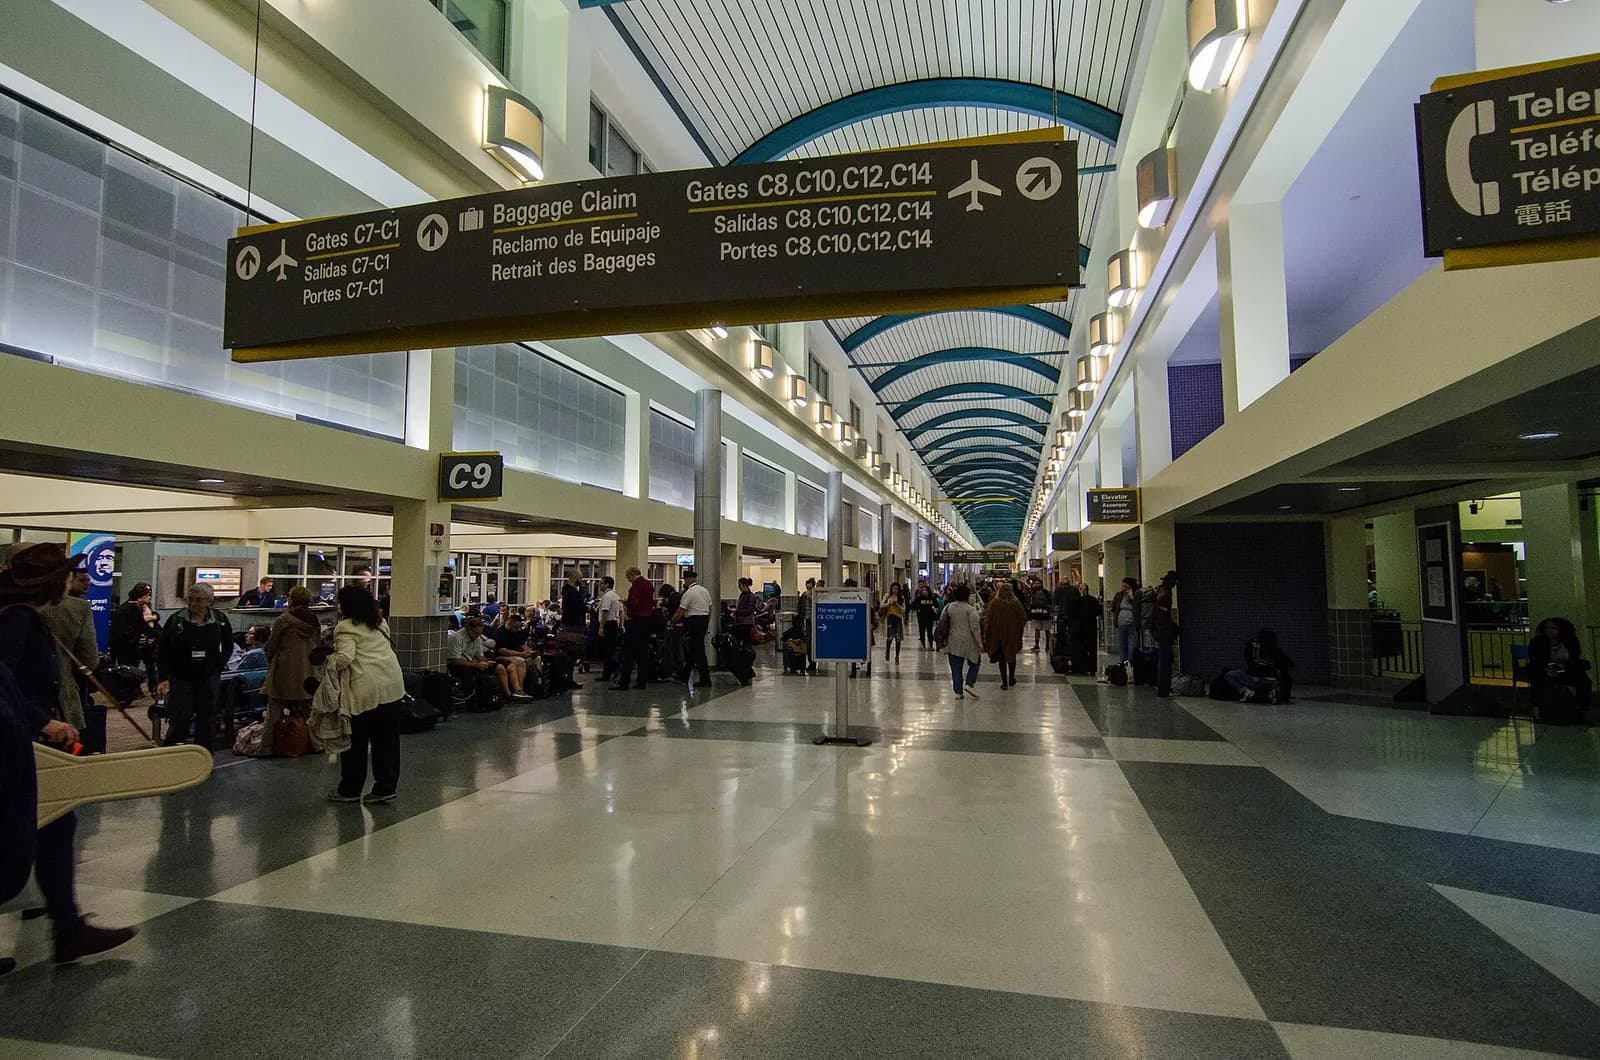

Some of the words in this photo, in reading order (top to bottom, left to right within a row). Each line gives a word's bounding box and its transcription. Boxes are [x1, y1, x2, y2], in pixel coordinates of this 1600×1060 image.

[686, 180, 748, 203] Gates
[758, 162, 933, 197] C8,C10,C12,C14
[492, 198, 574, 226] Baggage
[581, 188, 637, 213] Claim
[713, 212, 779, 234] Salidas
[785, 201, 933, 228] C8,C10,C12,C14
[1515, 199, 1572, 226] 電話
[306, 233, 348, 252] Gates
[354, 219, 400, 244] C7-C1
[492, 234, 559, 256] Reclamo
[564, 228, 584, 247] de
[591, 221, 661, 247] Equipaje
[720, 242, 779, 261] Portes
[785, 229, 933, 256] C8,C10,C12,C14
[304, 262, 347, 281] Salidas
[352, 253, 389, 274] C7-C1
[491, 259, 543, 282] Retrait
[548, 256, 577, 275] des
[583, 251, 656, 274] Bagages
[303, 287, 342, 305] Portes
[346, 278, 384, 299] C7-C1
[448, 462, 492, 490] C9
